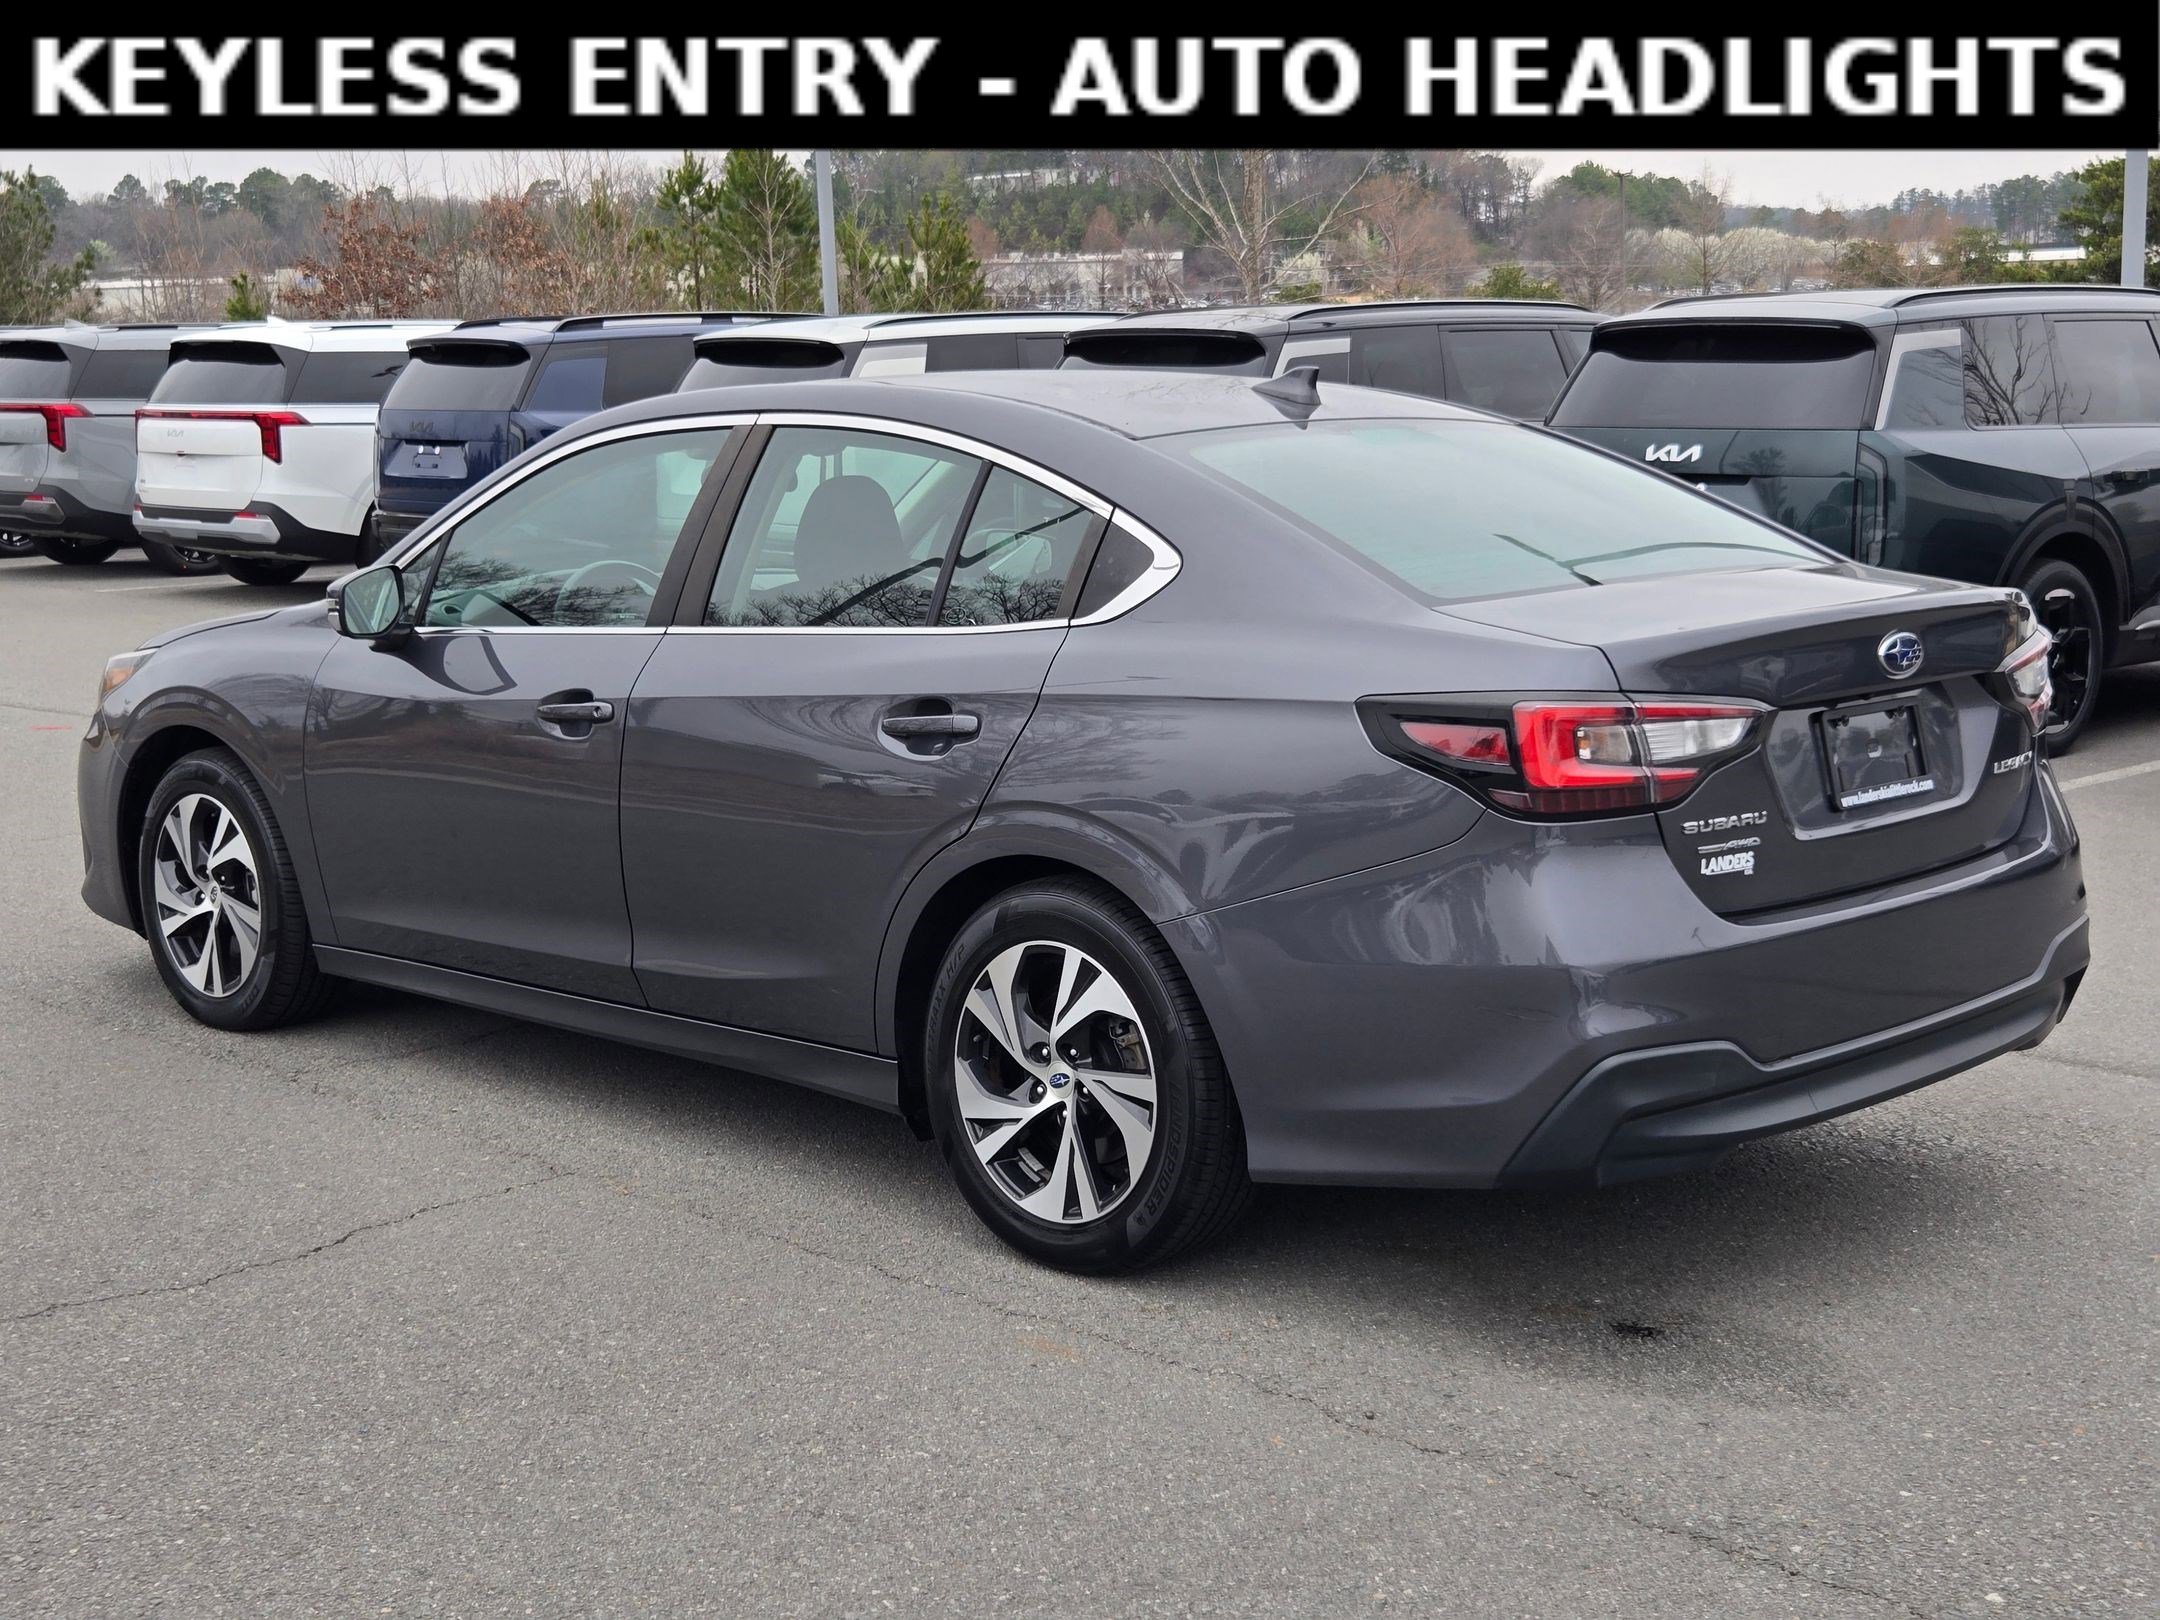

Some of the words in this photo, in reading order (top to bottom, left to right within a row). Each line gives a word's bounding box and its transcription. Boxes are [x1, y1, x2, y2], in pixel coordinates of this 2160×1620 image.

[1645, 444, 1703, 462] KIA
[1682, 810, 1767, 834] SUBARU
[1723, 836, 1761, 850] AWD
[1700, 850, 1755, 875] LANDERS
